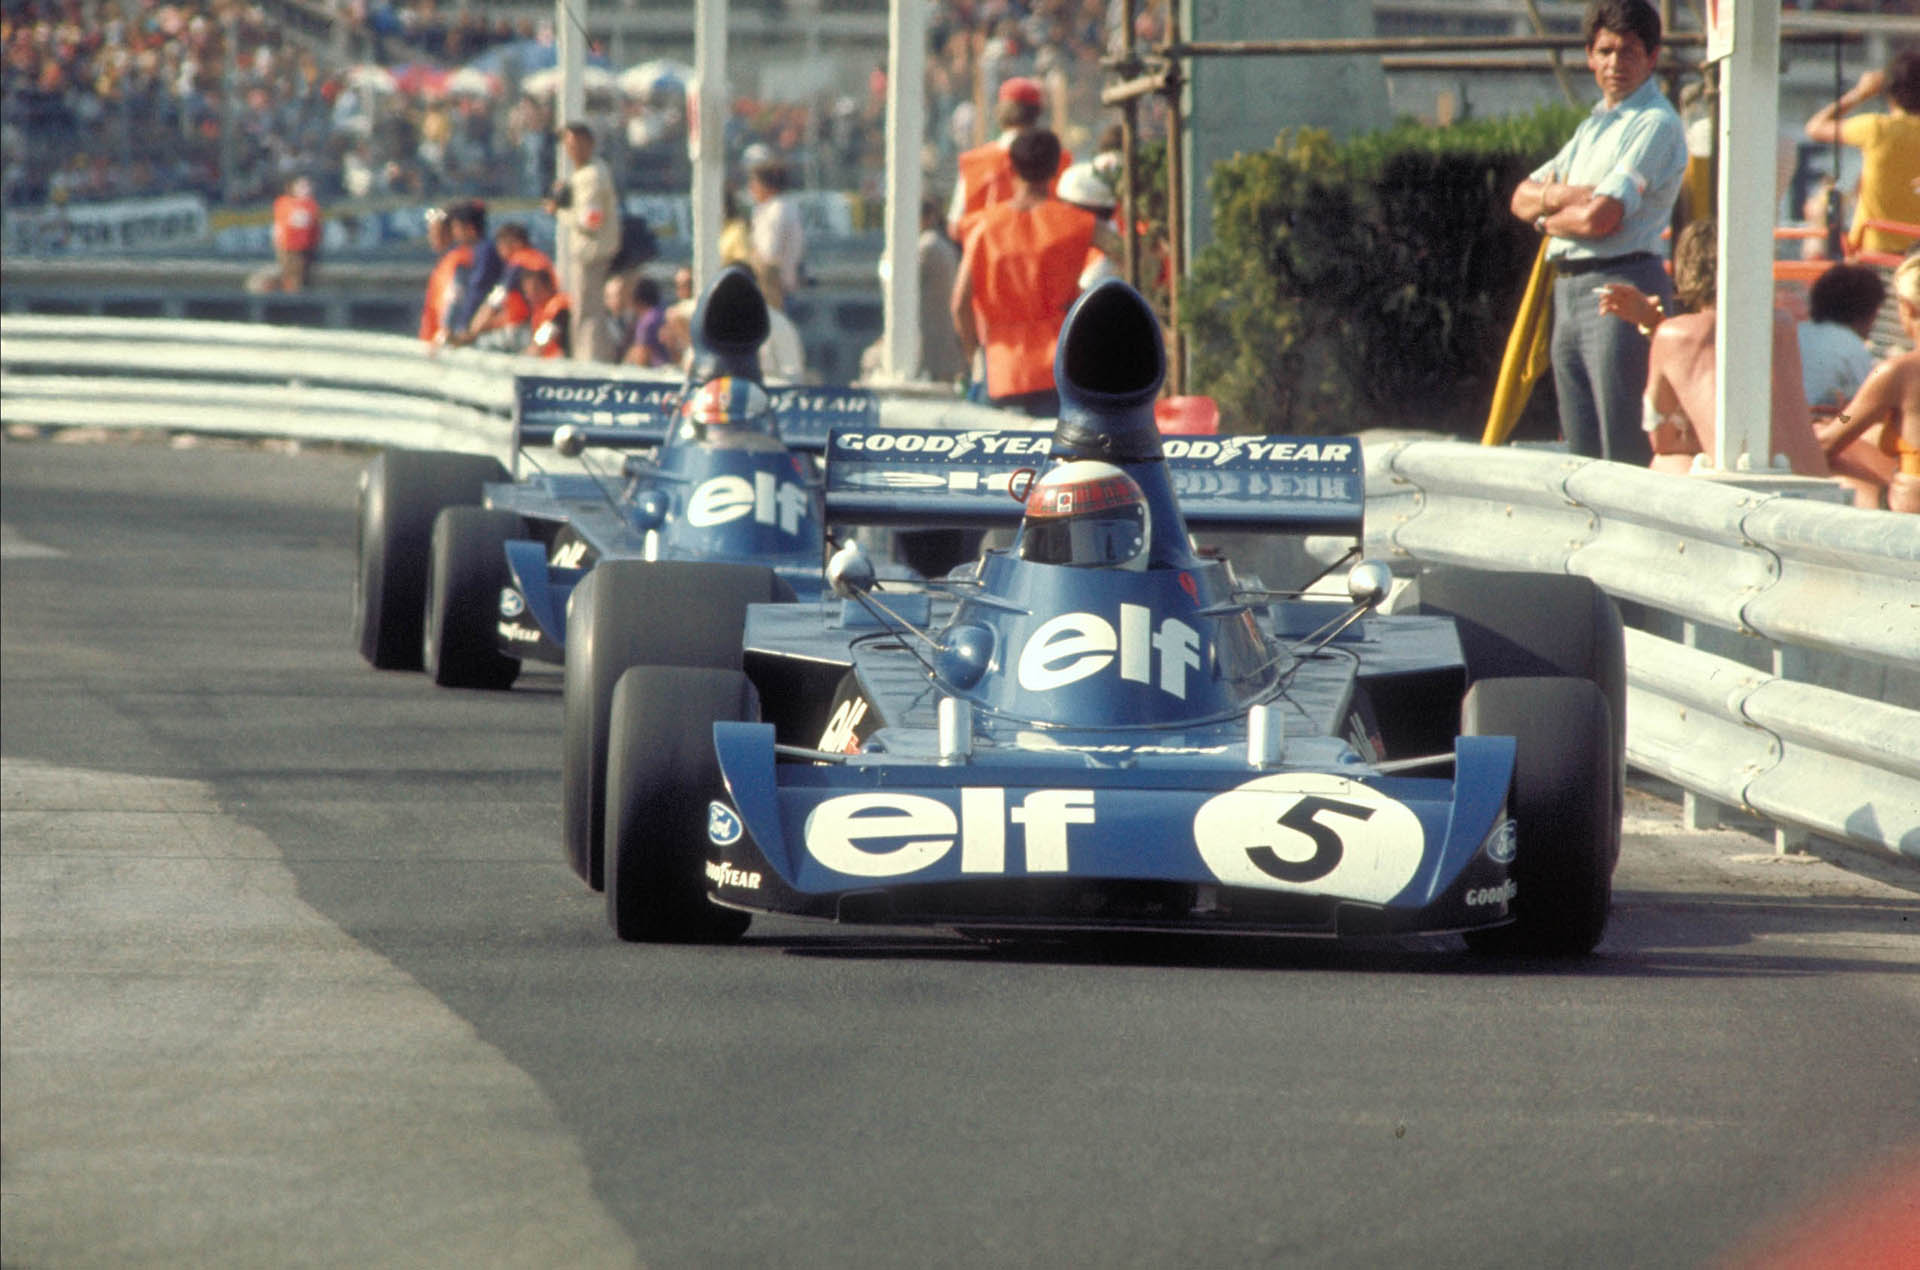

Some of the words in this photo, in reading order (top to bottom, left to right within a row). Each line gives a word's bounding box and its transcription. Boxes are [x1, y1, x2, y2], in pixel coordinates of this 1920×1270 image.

[836, 433, 1053, 456] GOODYEA
[1161, 437, 1353, 463] ODYEAR
[687, 471, 808, 536] elf
[1018, 603, 1200, 700] elf
[804, 787, 1096, 877] elf
[1244, 795, 1377, 883] 5
